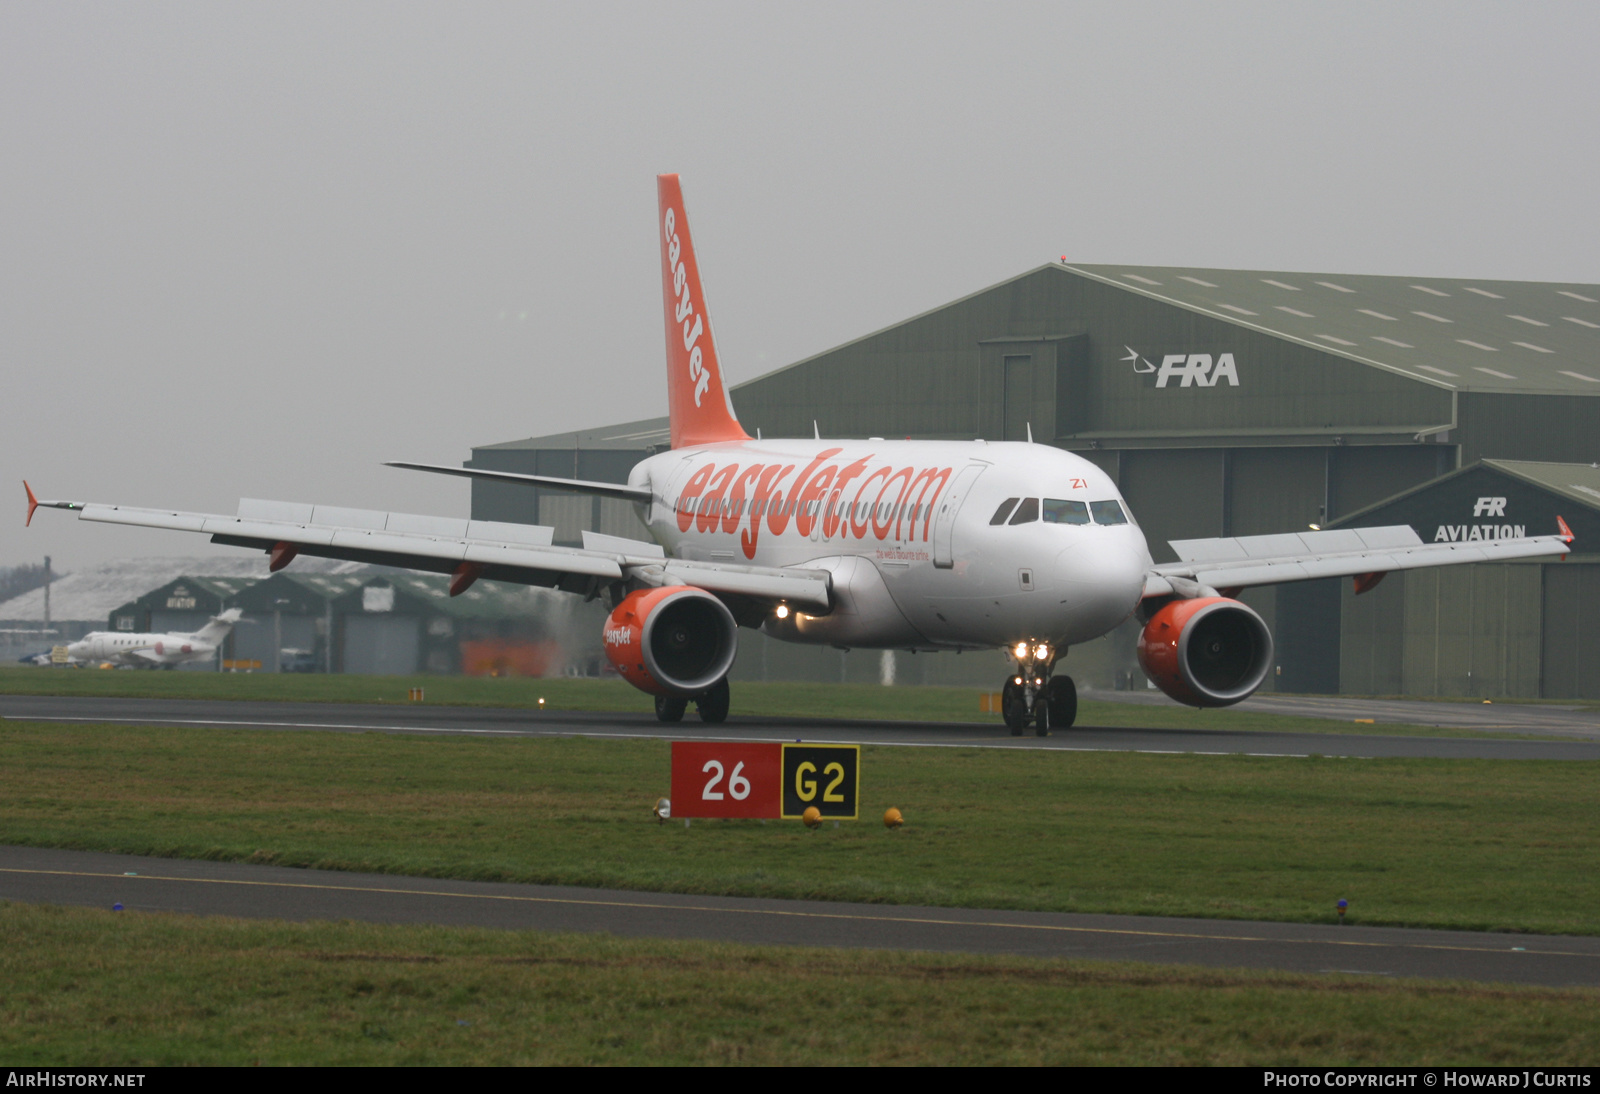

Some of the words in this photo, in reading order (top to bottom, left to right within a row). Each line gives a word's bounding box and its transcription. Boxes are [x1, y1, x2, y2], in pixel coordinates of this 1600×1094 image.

[664, 207, 711, 408] easyJet
[1155, 353, 1239, 388] FRA
[676, 447, 952, 560] easyJet.com
[1473, 497, 1507, 517] FR
[1434, 525, 1526, 542] AVIATION
[606, 626, 631, 647] easyJet
[702, 759, 751, 801] 26
[795, 761, 845, 802] G2
